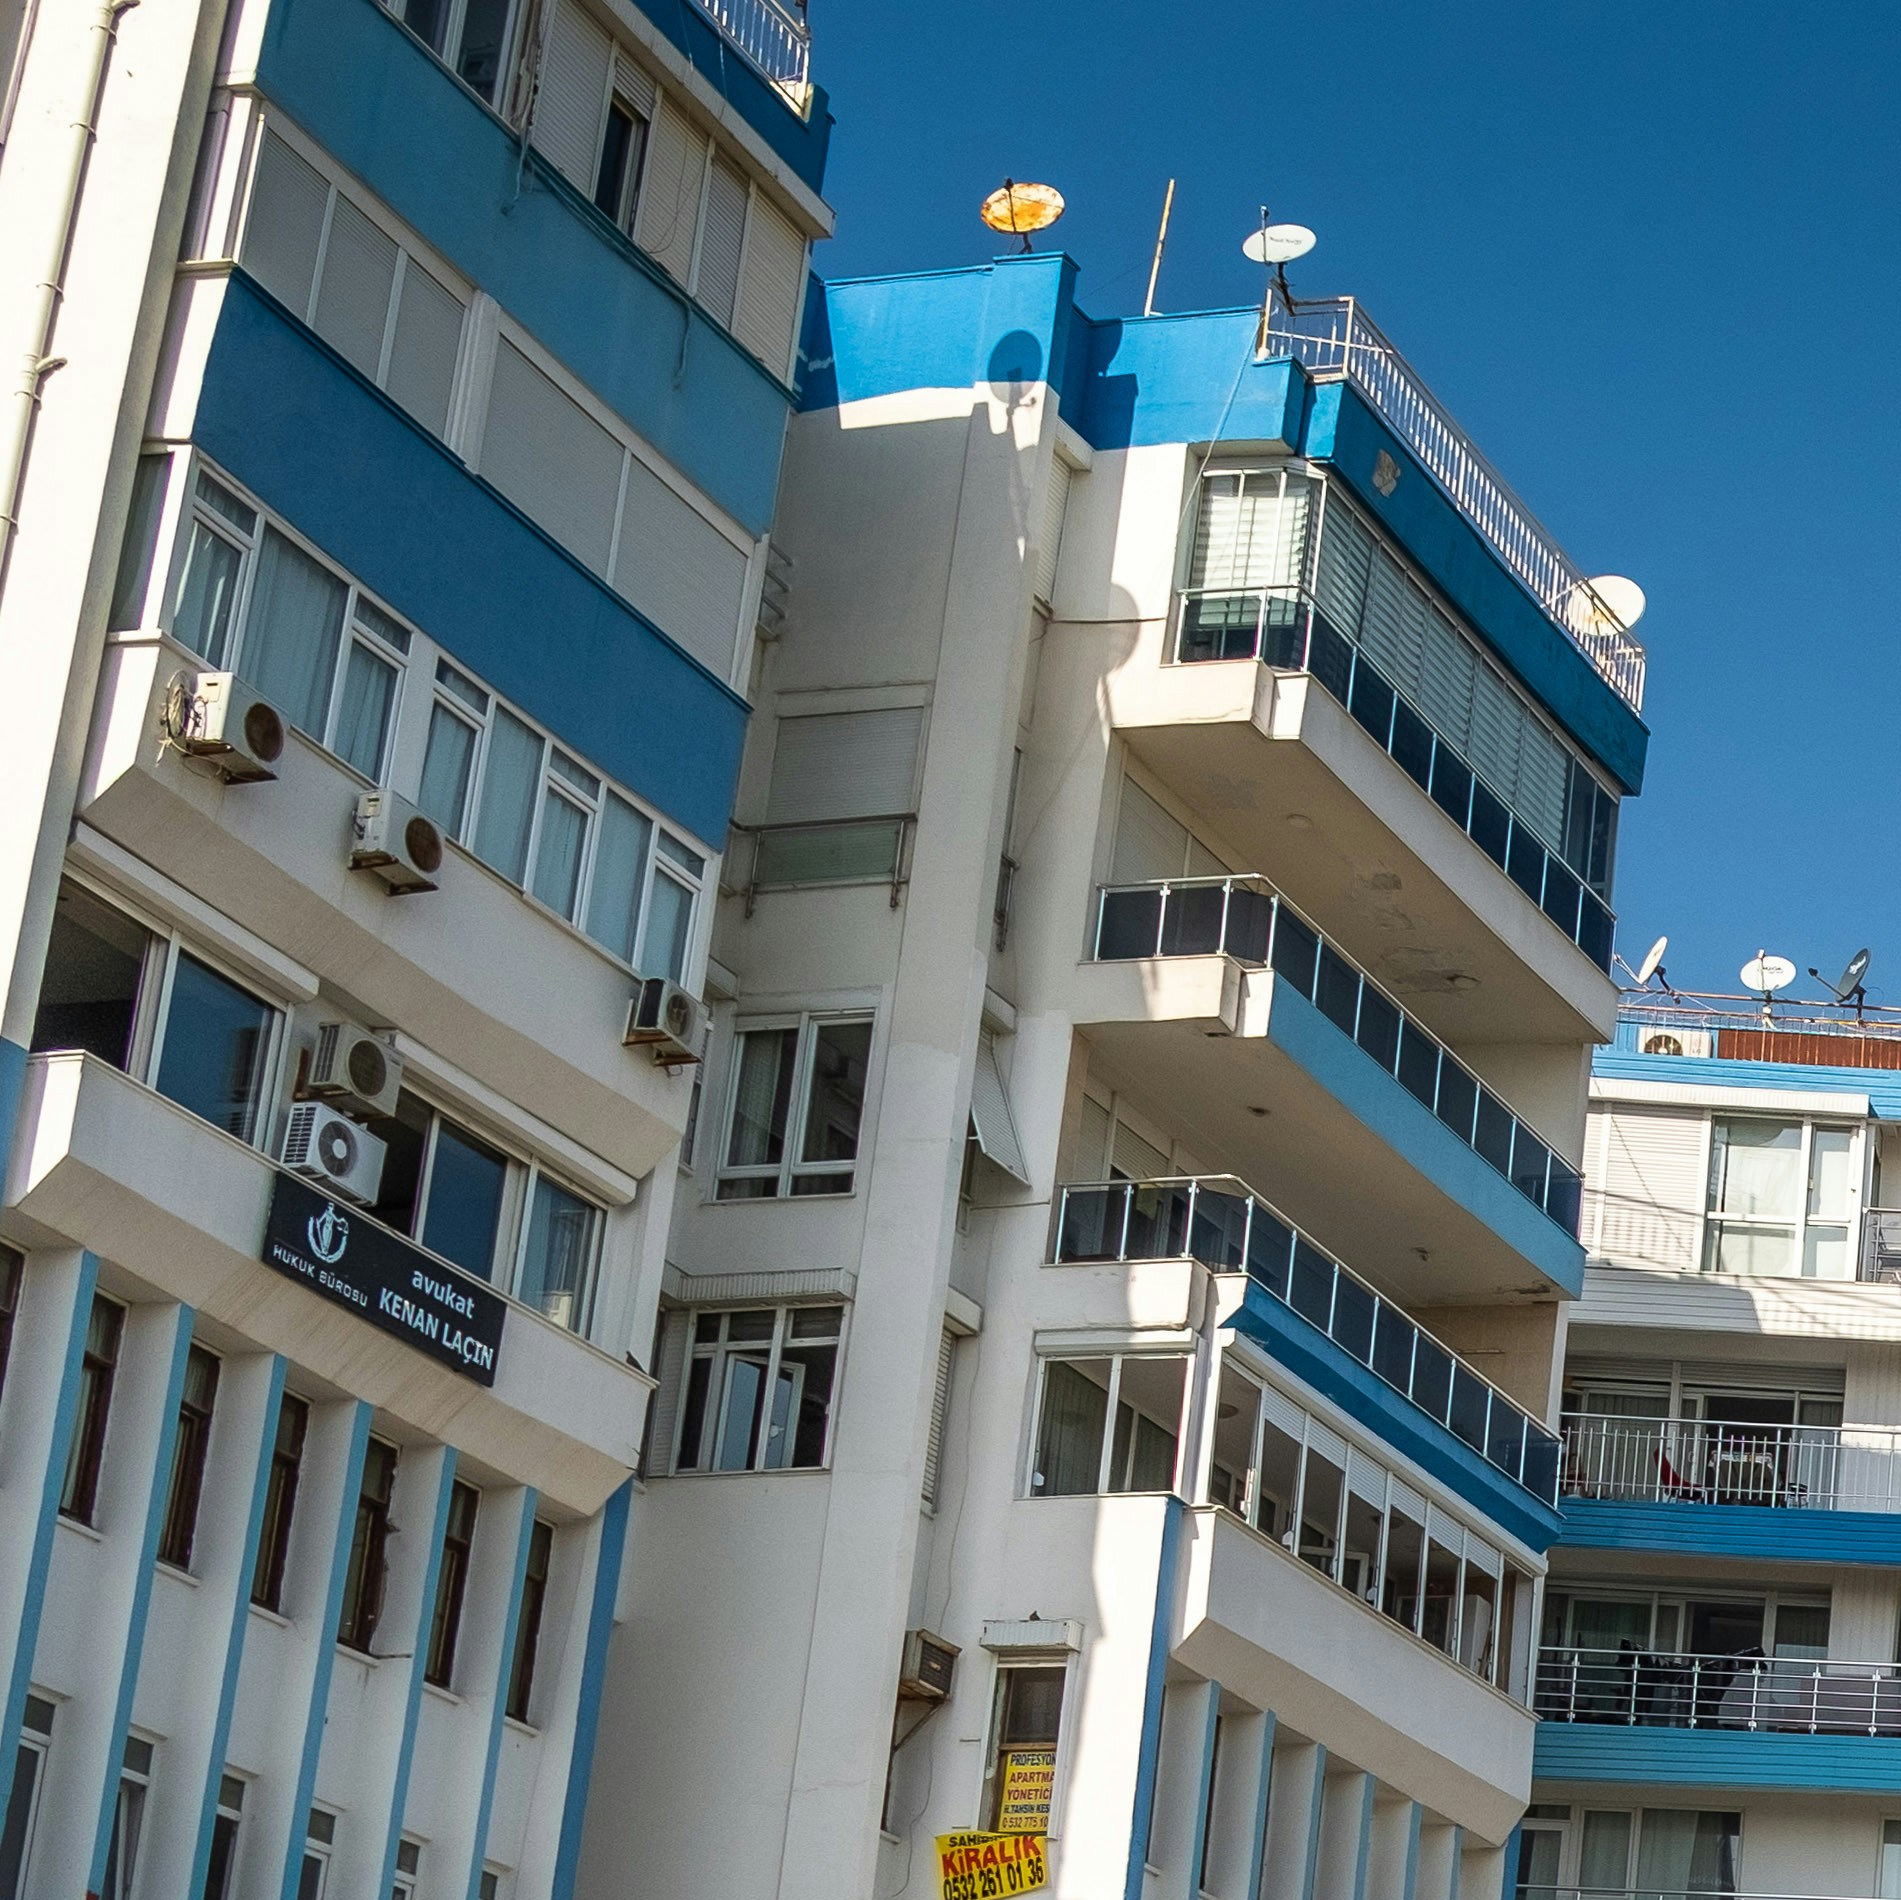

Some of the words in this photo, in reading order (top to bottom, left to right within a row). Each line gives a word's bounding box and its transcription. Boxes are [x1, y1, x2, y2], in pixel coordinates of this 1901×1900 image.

[273, 1244, 315, 1278] HUKUK
[320, 1272, 368, 1307] BÜROSU
[412, 1270, 475, 1319] avukat
[379, 1287, 439, 1340] KENAN
[941, 1835, 1042, 1878] KİRALIK
[979, 1865, 1004, 1898] 261
[1006, 1861, 1024, 1891] 01
[1028, 1856, 1045, 1886] 36
